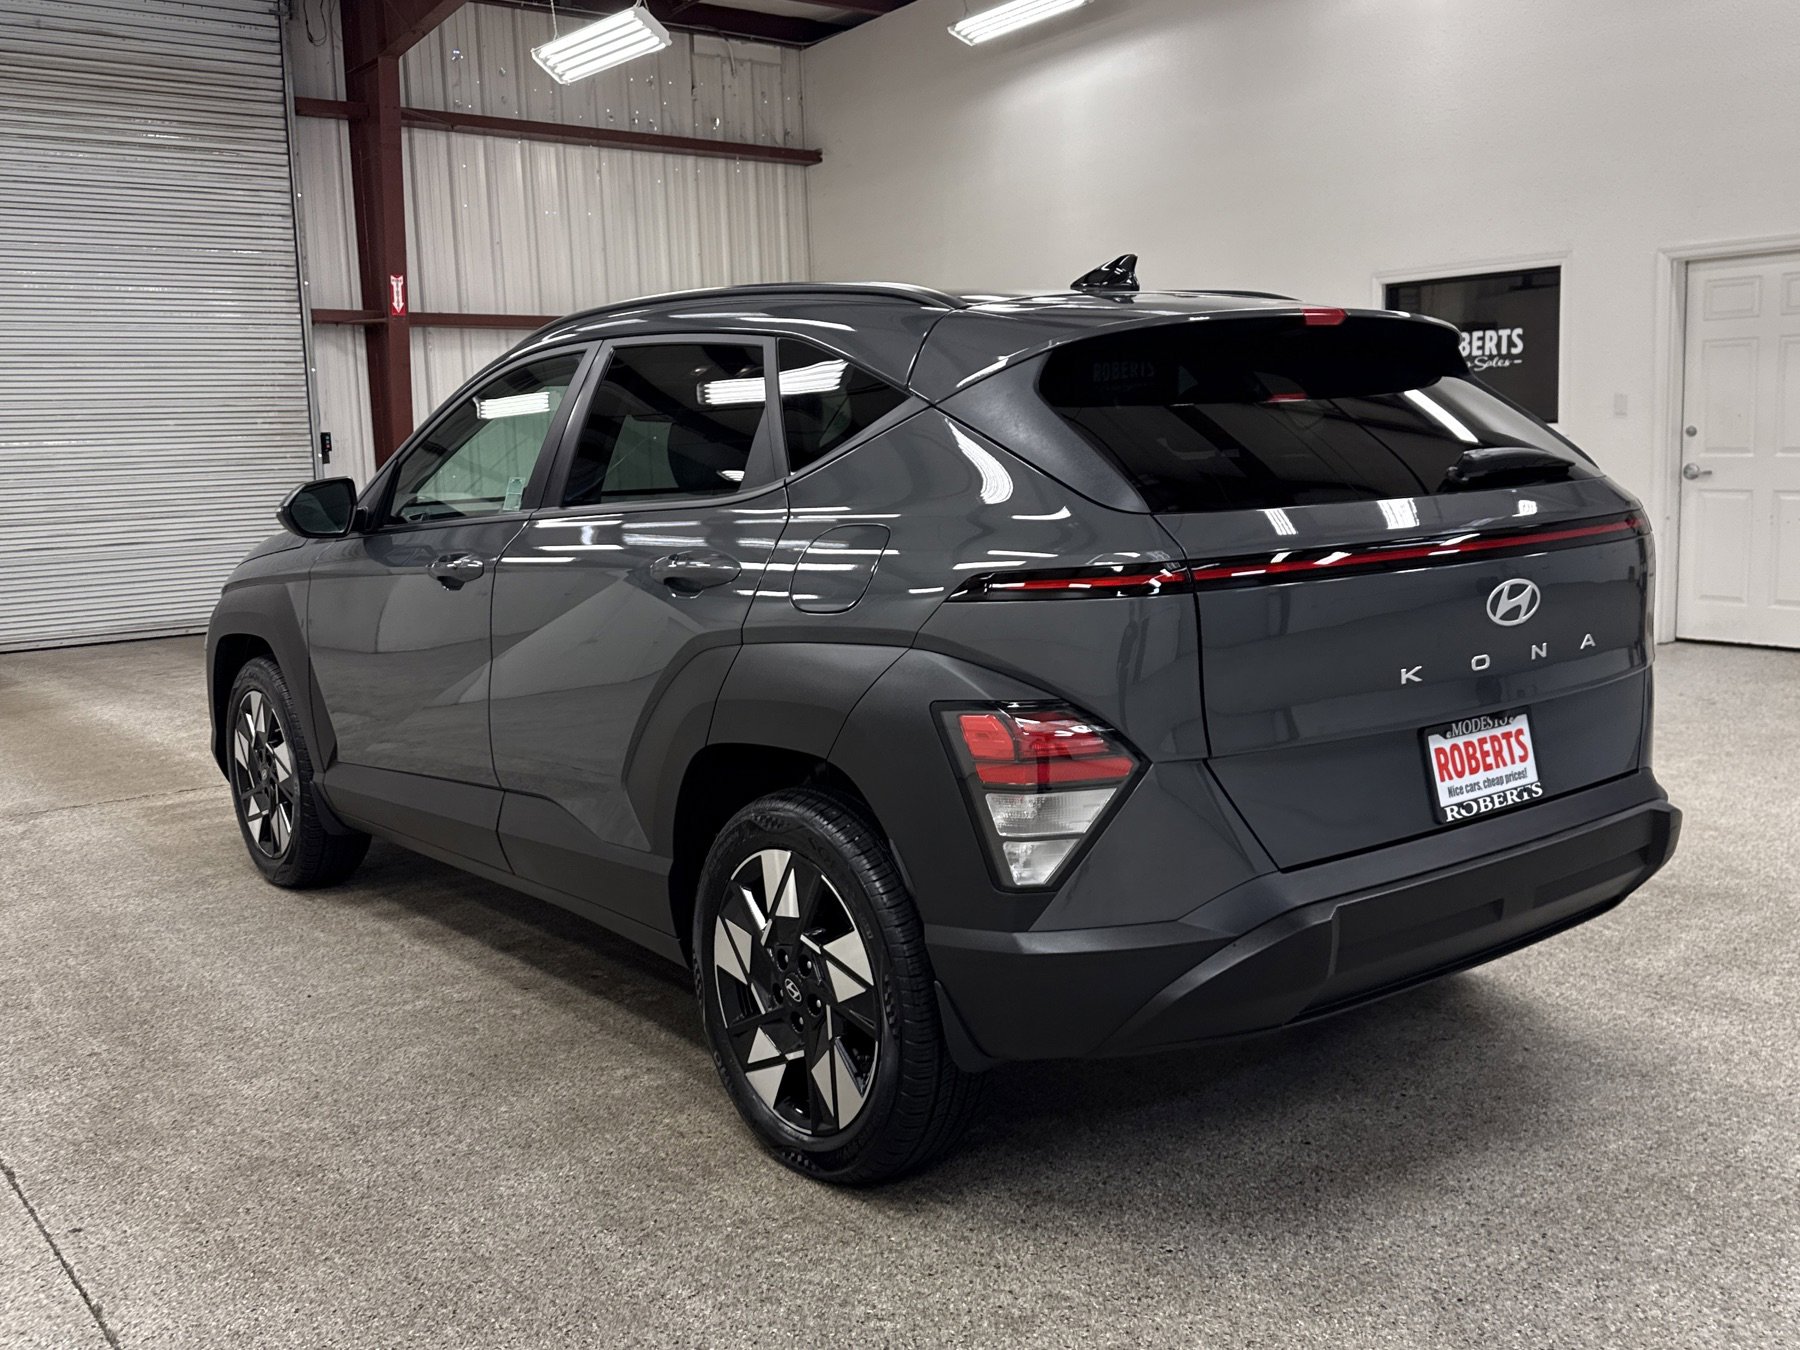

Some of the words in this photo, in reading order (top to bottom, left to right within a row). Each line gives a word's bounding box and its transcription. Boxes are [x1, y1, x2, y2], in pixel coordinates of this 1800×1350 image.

[1459, 327, 1524, 357] BERTS
[1473, 356, 1512, 372] Sales
[1400, 633, 1596, 685] KONA
[1434, 728, 1530, 783] ROBERTS
[1447, 785, 1464, 798] Nice
[1483, 775, 1504, 790] cheap
[1505, 767, 1528, 785] prices!
[1444, 781, 1543, 822] ROBERTS
